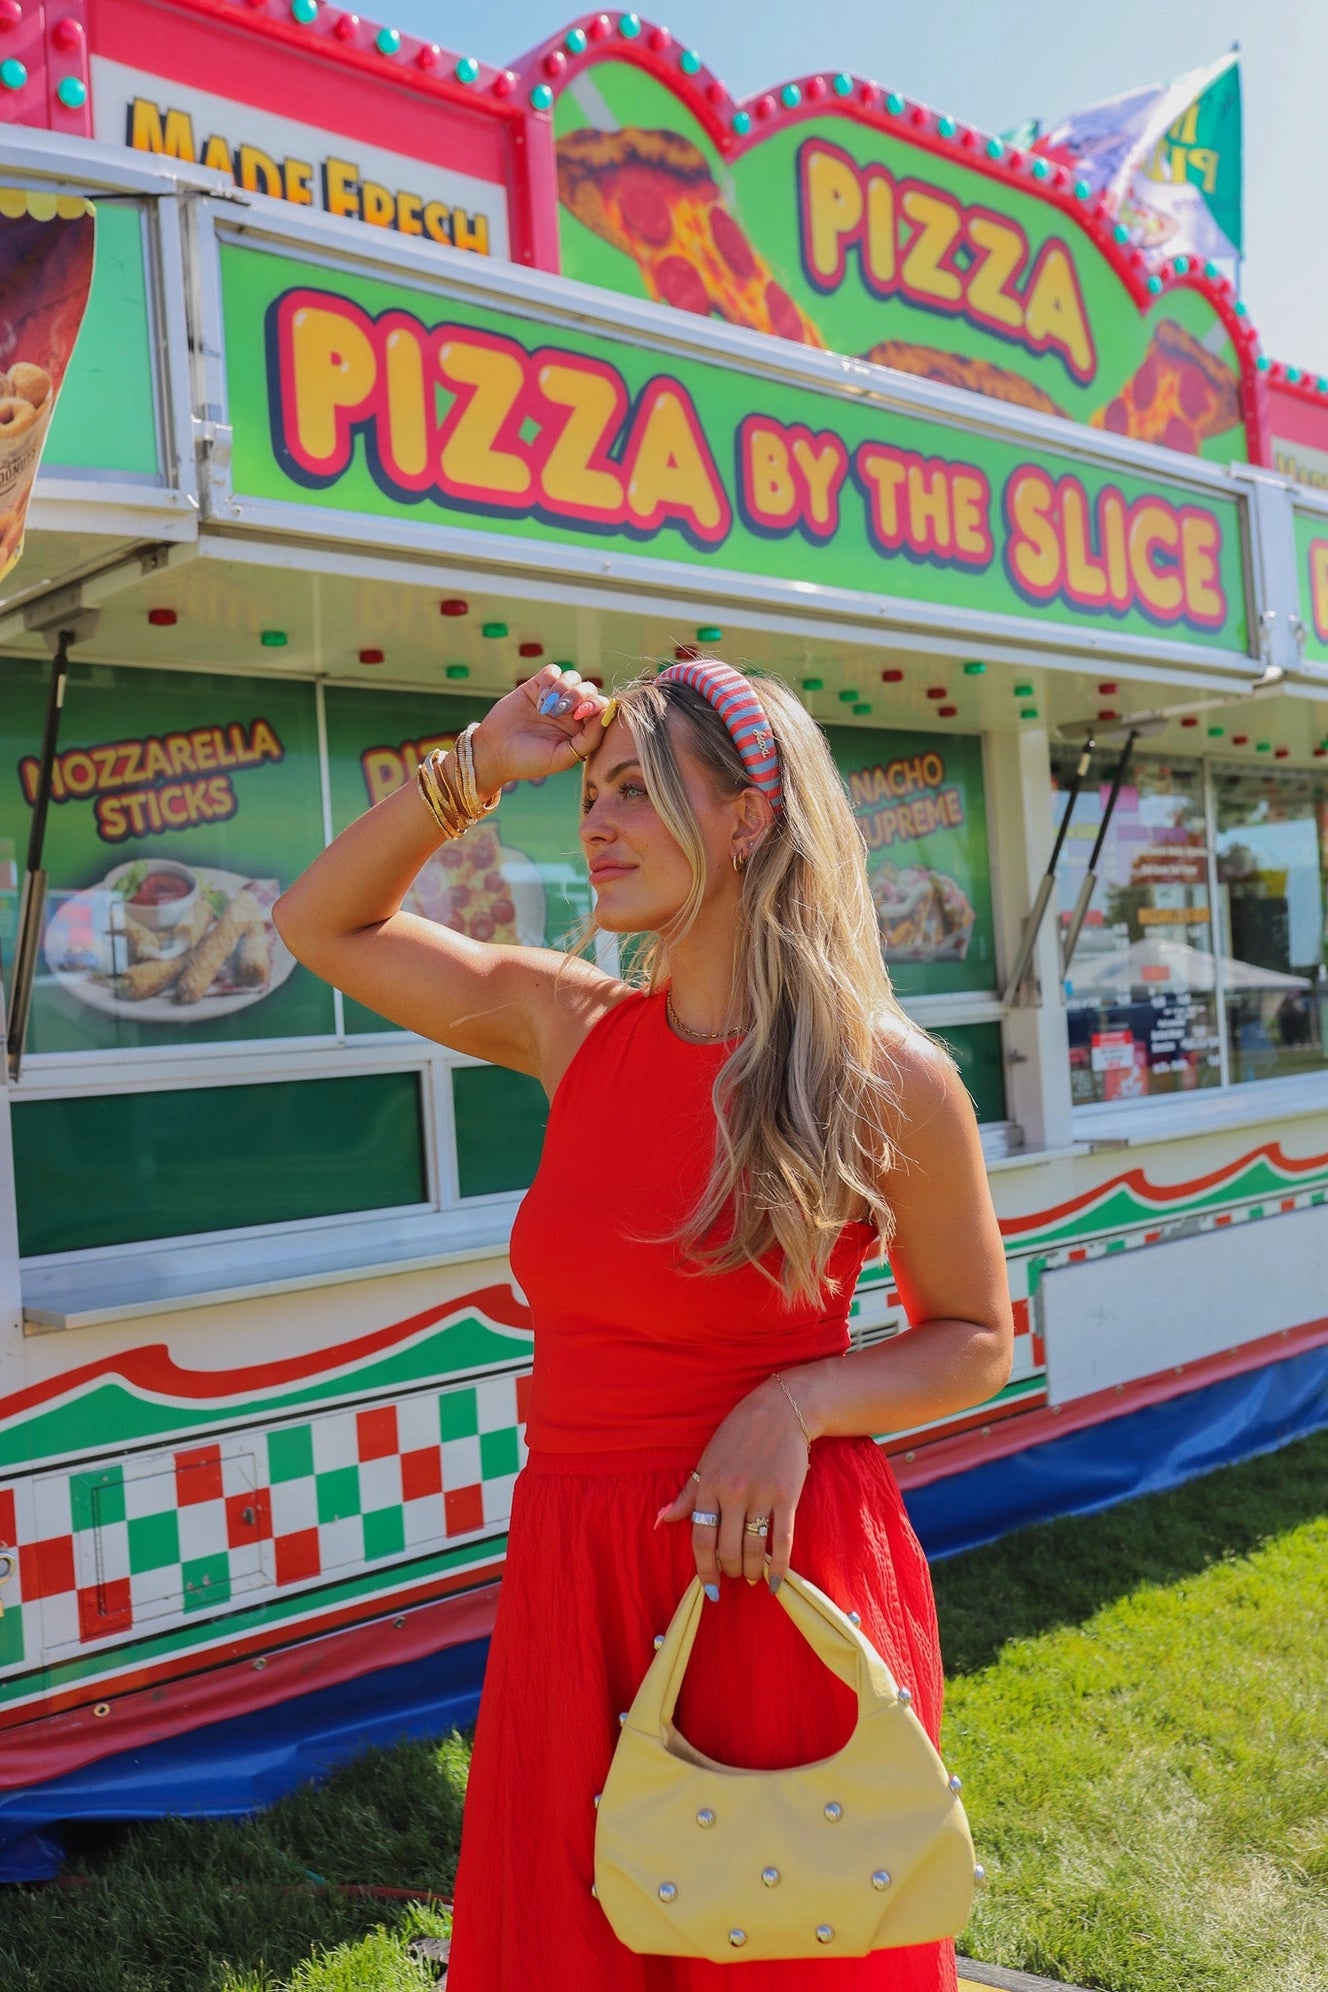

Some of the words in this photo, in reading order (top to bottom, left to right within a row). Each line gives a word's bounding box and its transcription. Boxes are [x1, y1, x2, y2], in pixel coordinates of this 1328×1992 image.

[799, 138, 1097, 383] PIZZA
[276, 290, 733, 544] PIZZA
[739, 415, 848, 538] BY
[855, 442, 992, 566] THE
[1005, 464, 1227, 629] SLICE
[20, 719, 283, 804] MOZZARELLA
[849, 751, 945, 807] NACHO
[97, 775, 236, 841] STICKS
[860, 788, 963, 851] UPREME
